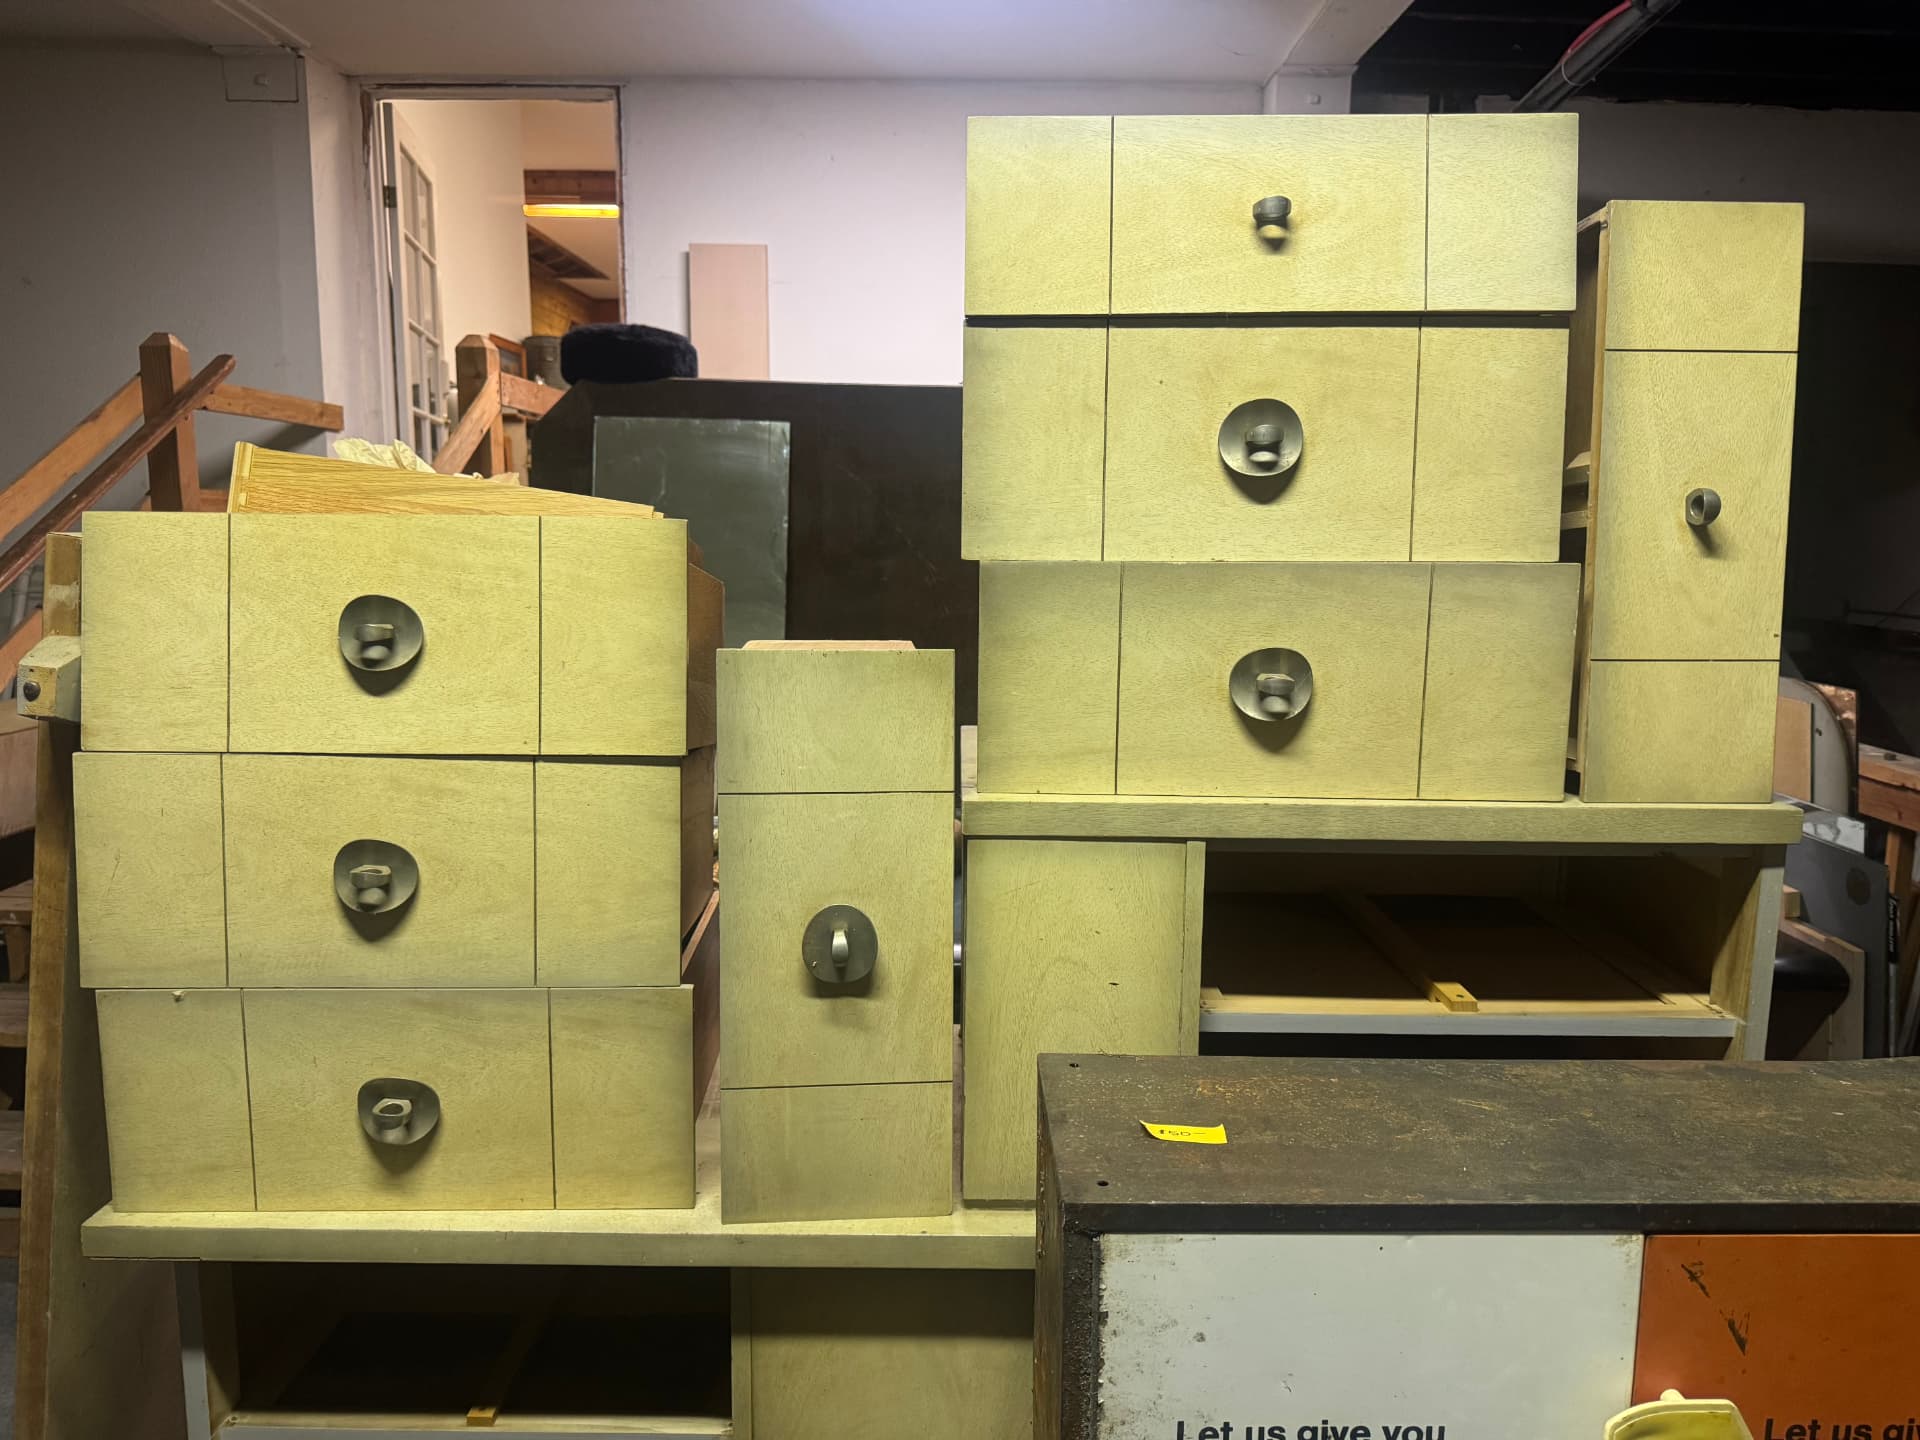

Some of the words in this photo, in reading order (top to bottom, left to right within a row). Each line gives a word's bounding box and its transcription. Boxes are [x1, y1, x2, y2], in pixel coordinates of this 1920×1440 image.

[1177, 1420, 1233, 1440] Let
[1246, 1425, 1287, 1440] us
[1297, 1419, 1371, 1440] give
[1382, 1425, 1445, 1440] you
[1765, 1418, 1821, 1440] Let
[1832, 1424, 1872, 1440] us
[1883, 1418, 1920, 1440] gi
